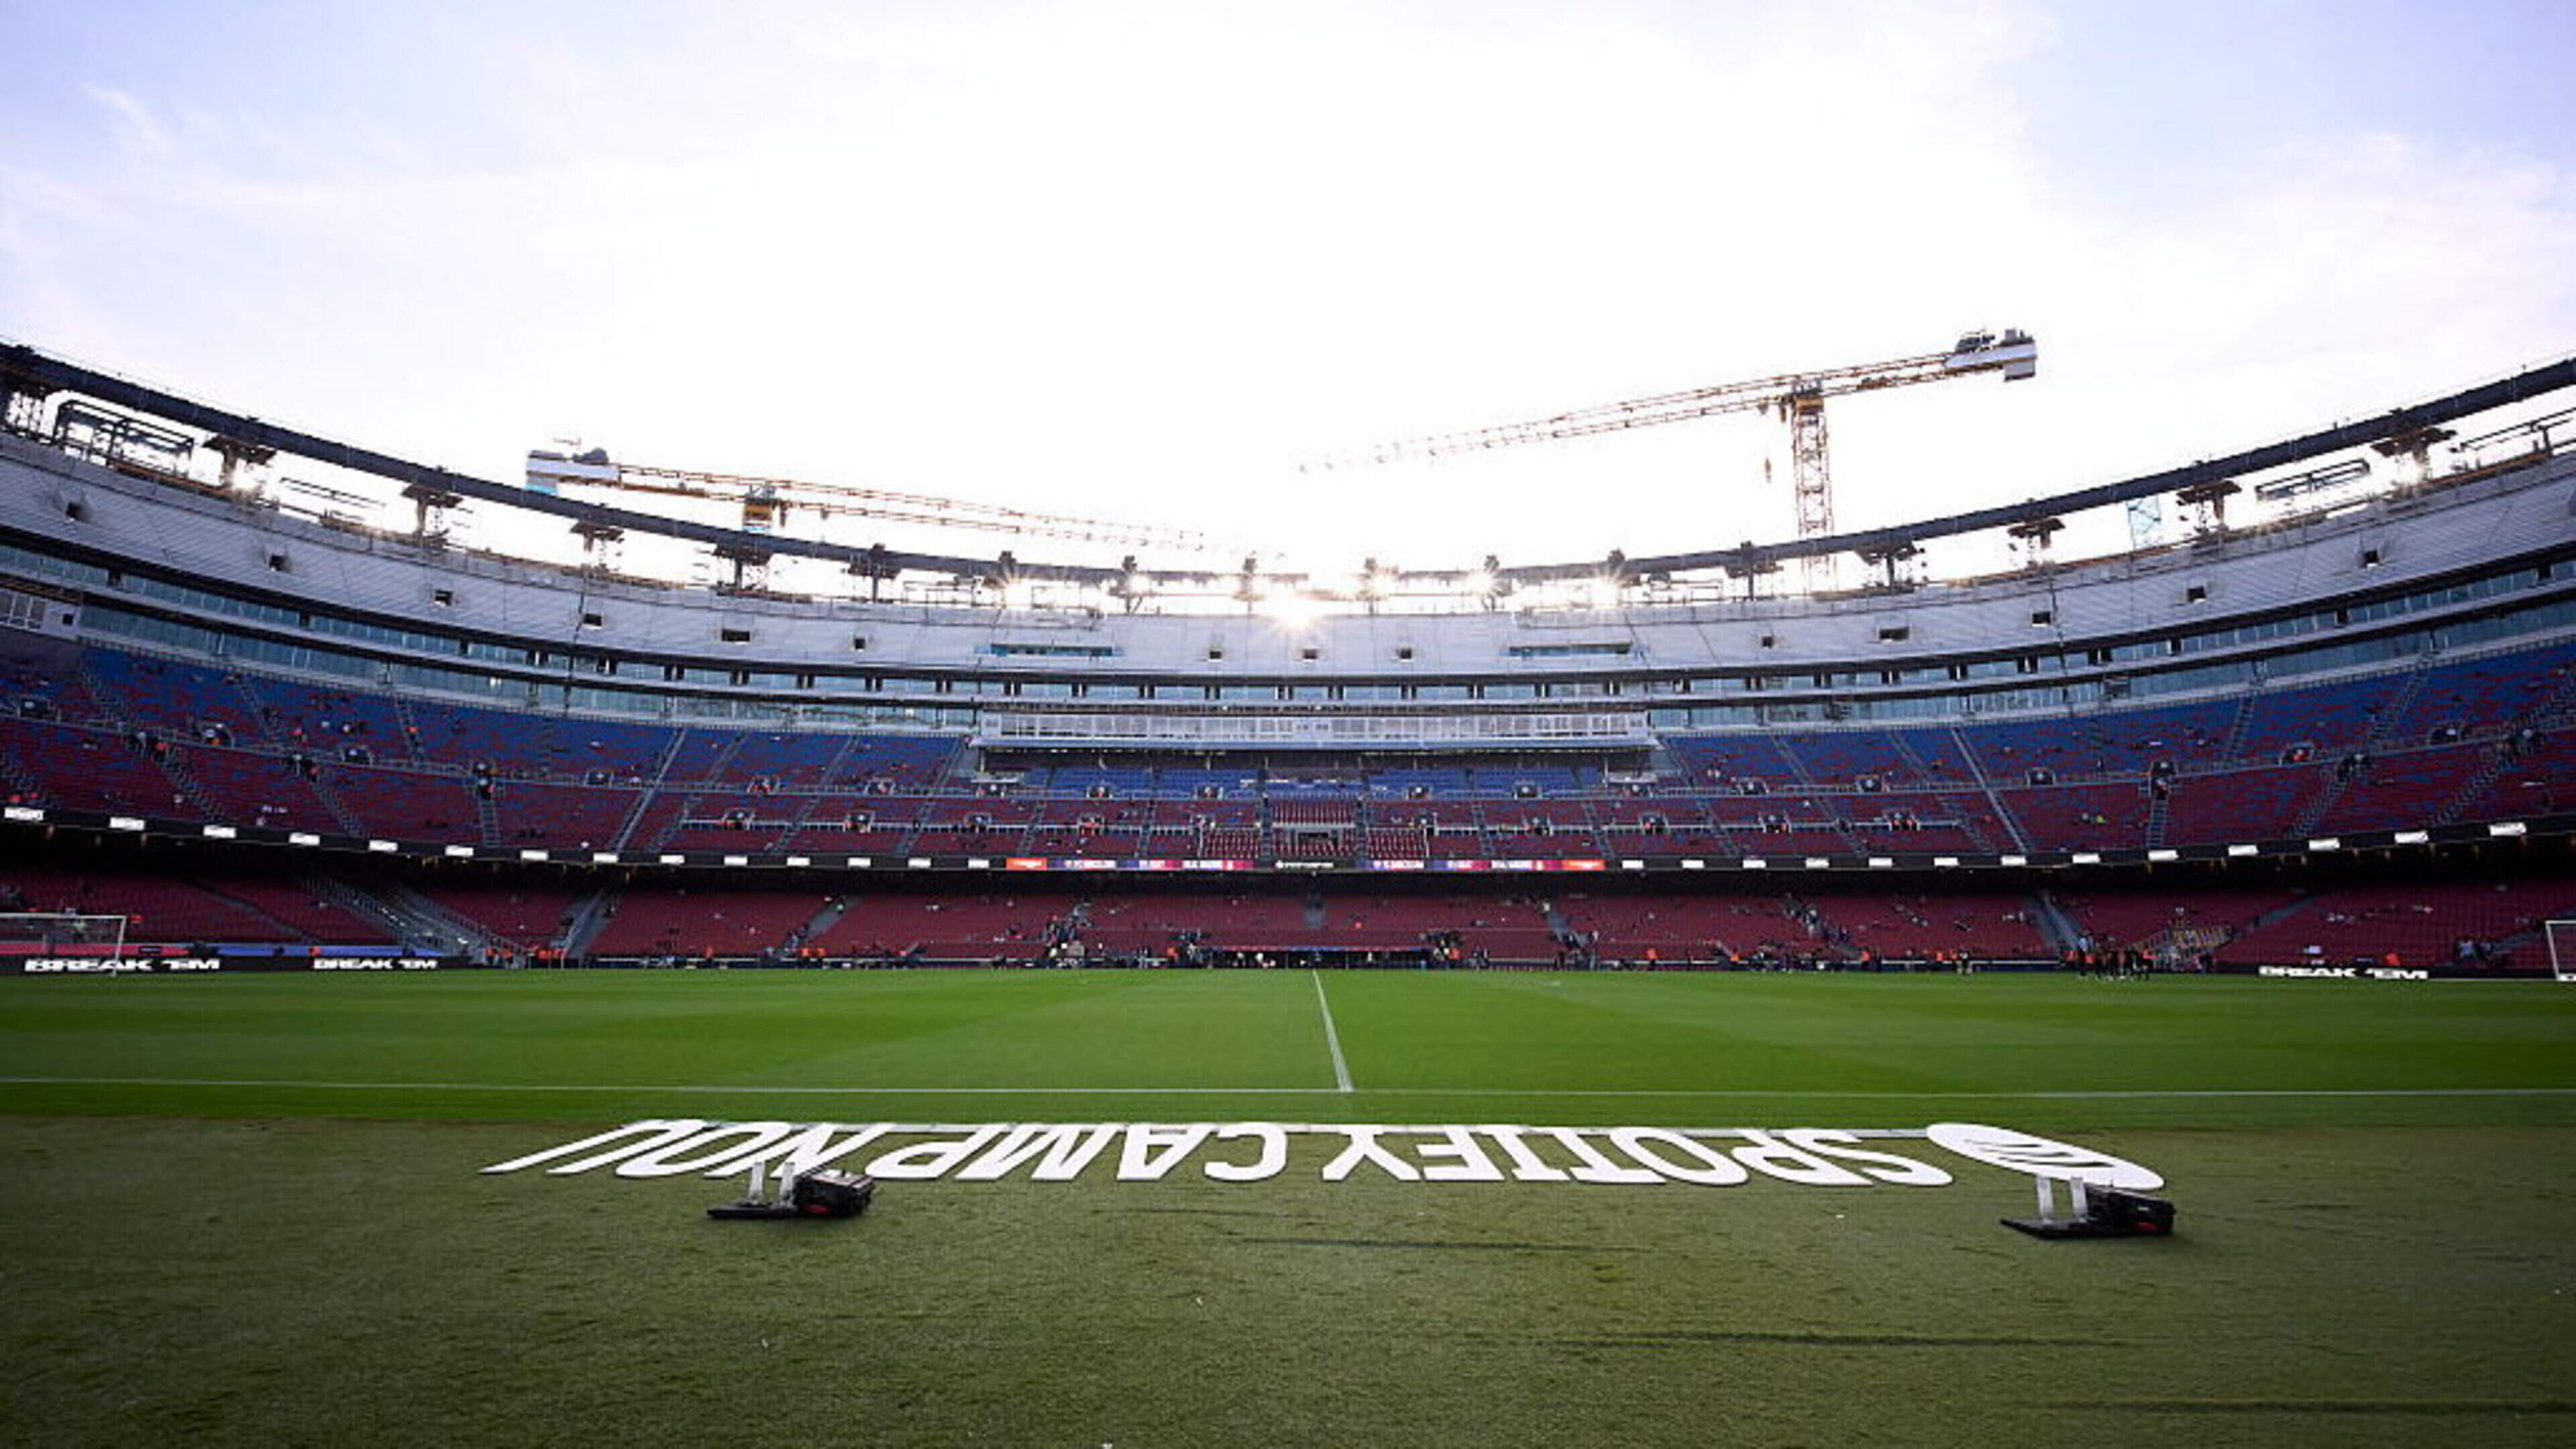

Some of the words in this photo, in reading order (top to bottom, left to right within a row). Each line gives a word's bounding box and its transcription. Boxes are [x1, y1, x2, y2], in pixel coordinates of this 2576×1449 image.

[25, 959, 152, 971] BREAK
[476, 1119, 895, 1177] NOU
[865, 1122, 1287, 1180] CAMP
[1322, 1124, 1953, 1185] SPOTIFY
